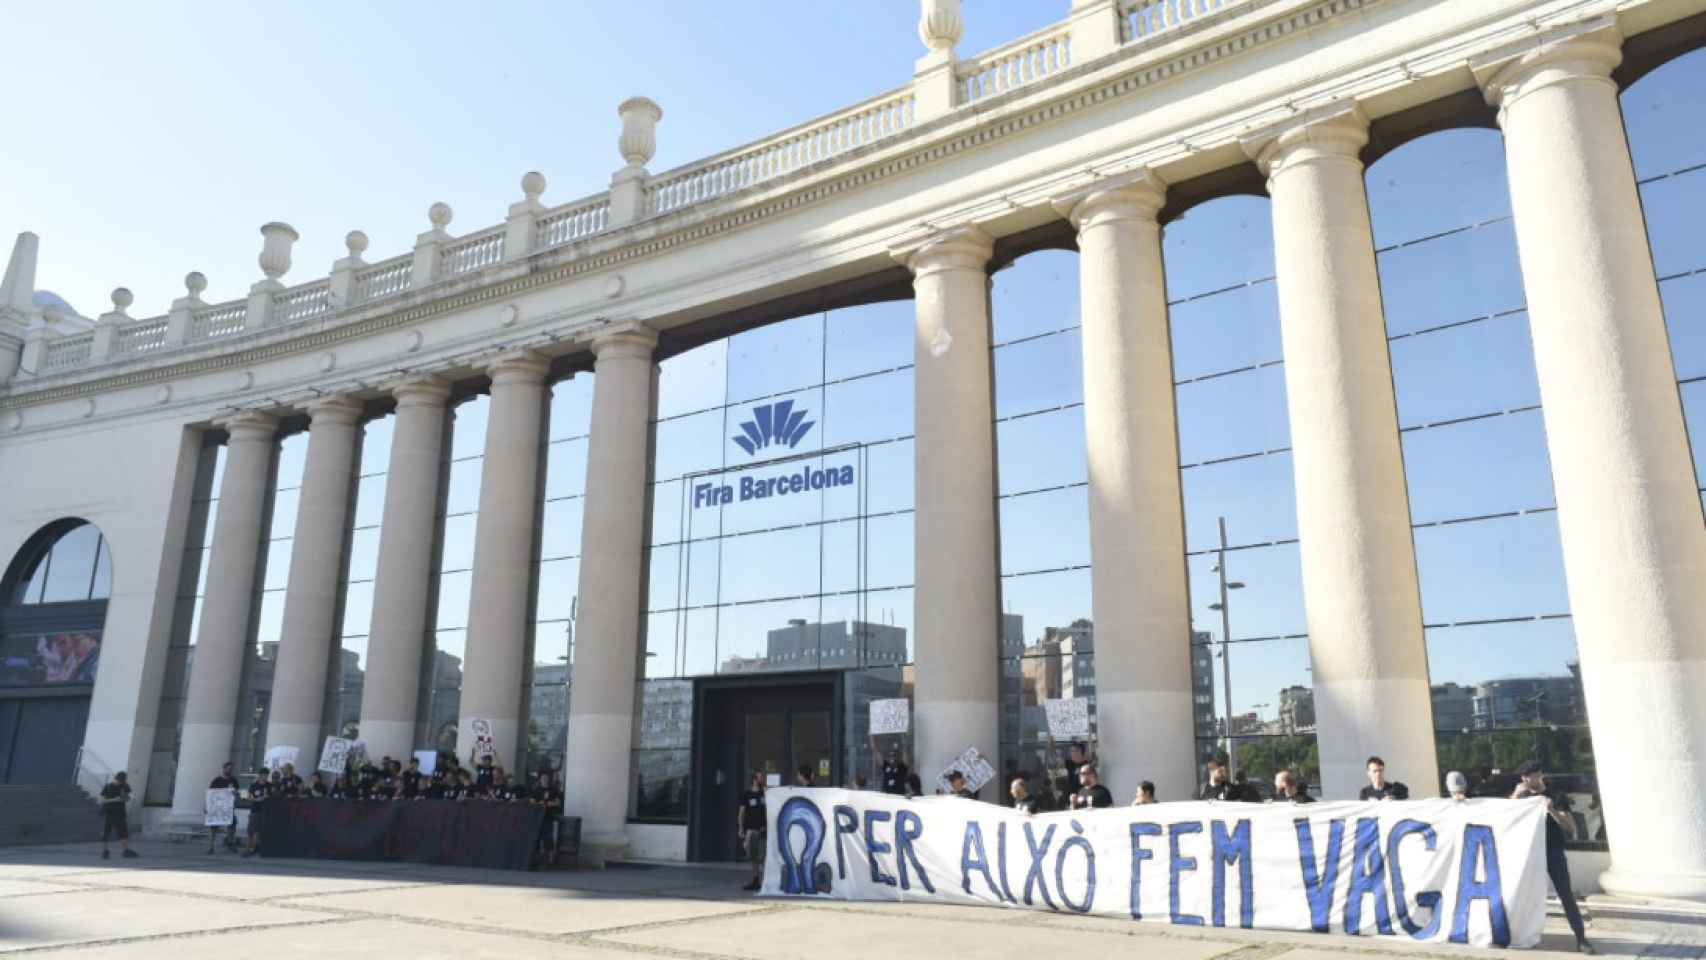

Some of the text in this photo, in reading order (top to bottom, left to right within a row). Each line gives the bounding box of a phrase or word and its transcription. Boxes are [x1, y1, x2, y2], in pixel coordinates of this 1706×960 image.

[694, 464, 854, 509] Fira Barcelona
[833, 804, 1511, 947] PER AIXÒ FEM VAGA
